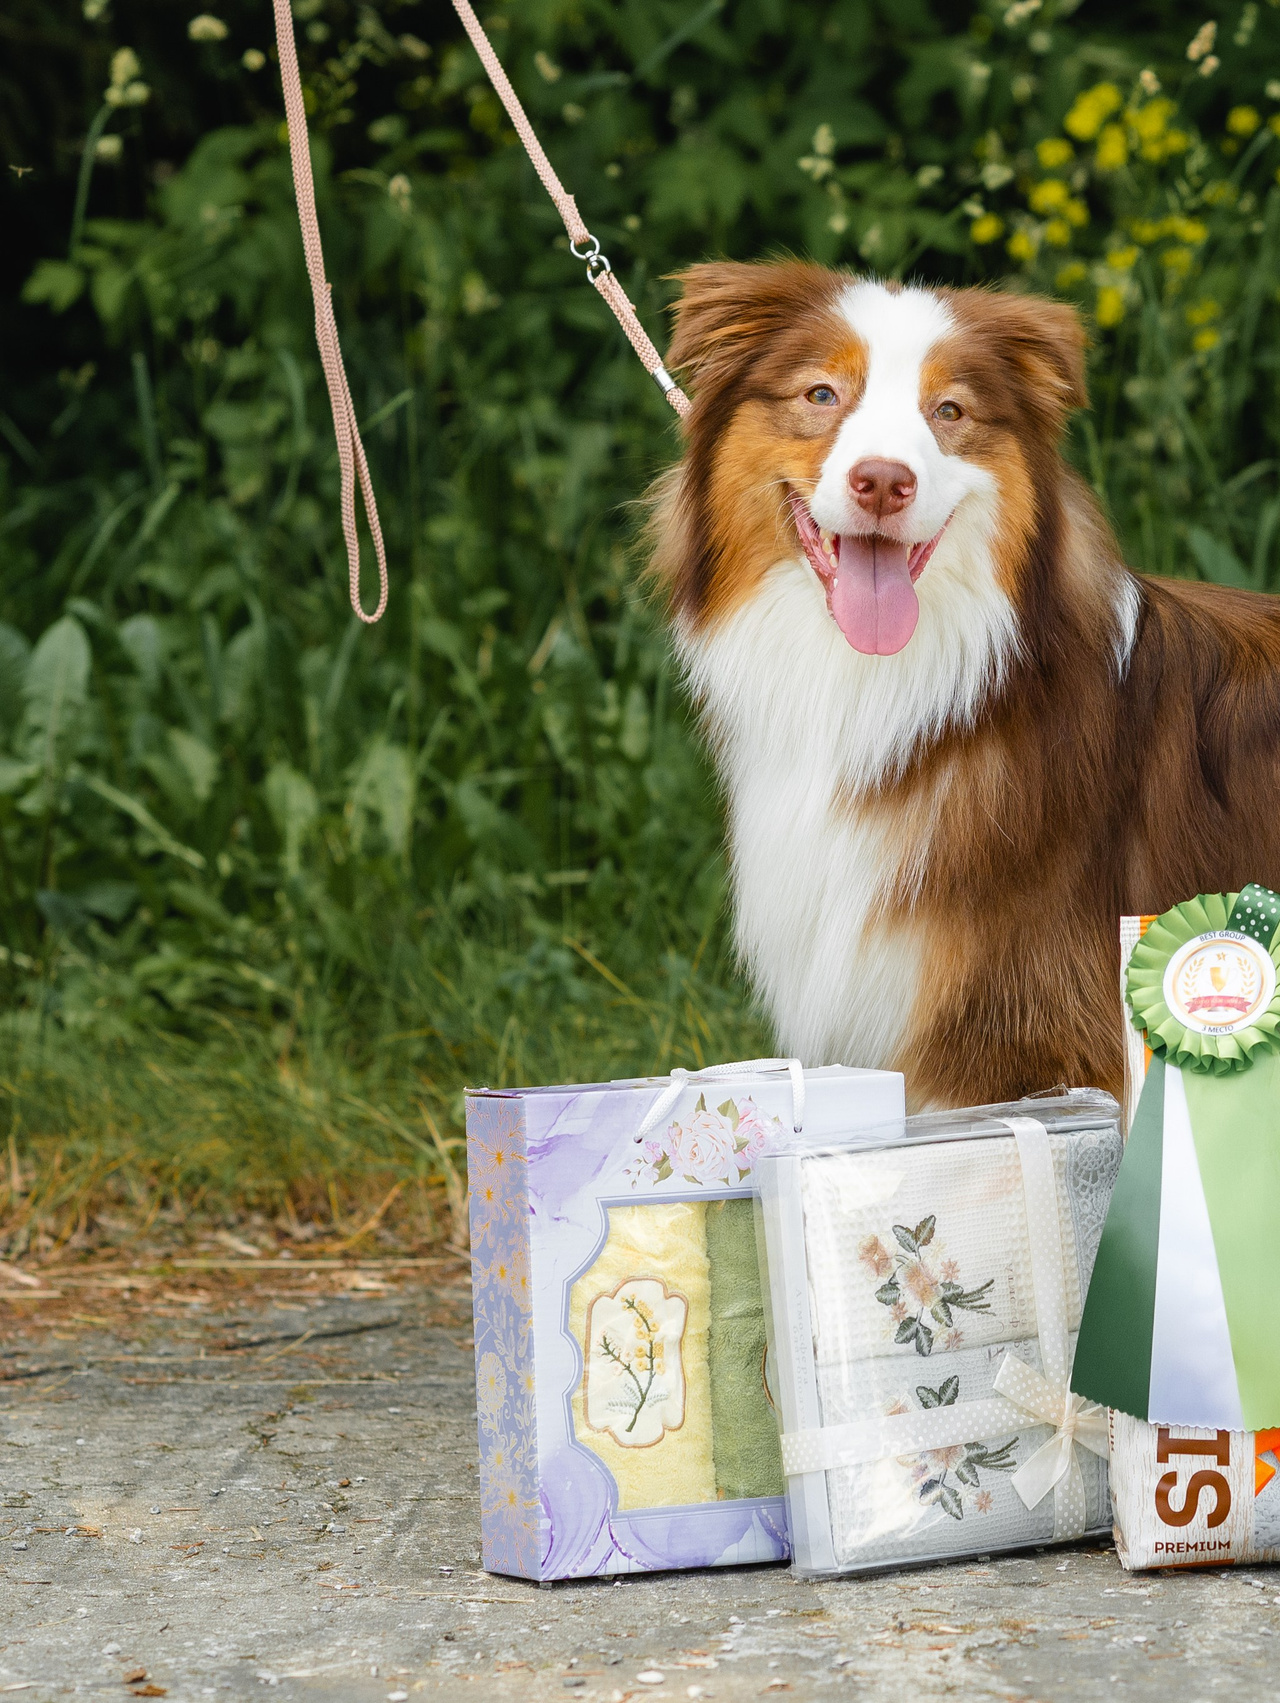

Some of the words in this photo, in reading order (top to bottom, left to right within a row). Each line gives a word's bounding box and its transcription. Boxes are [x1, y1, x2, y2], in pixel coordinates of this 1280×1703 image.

[1199, 931, 1217, 942] BEST
[1218, 930, 1246, 941] GROUP
[1208, 1024, 1234, 1034] МЕСТО
[795, 1288, 810, 1386] Атмосфера
[1155, 1427, 1232, 1529] SI
[1154, 1540, 1231, 1554] PREMIUM
